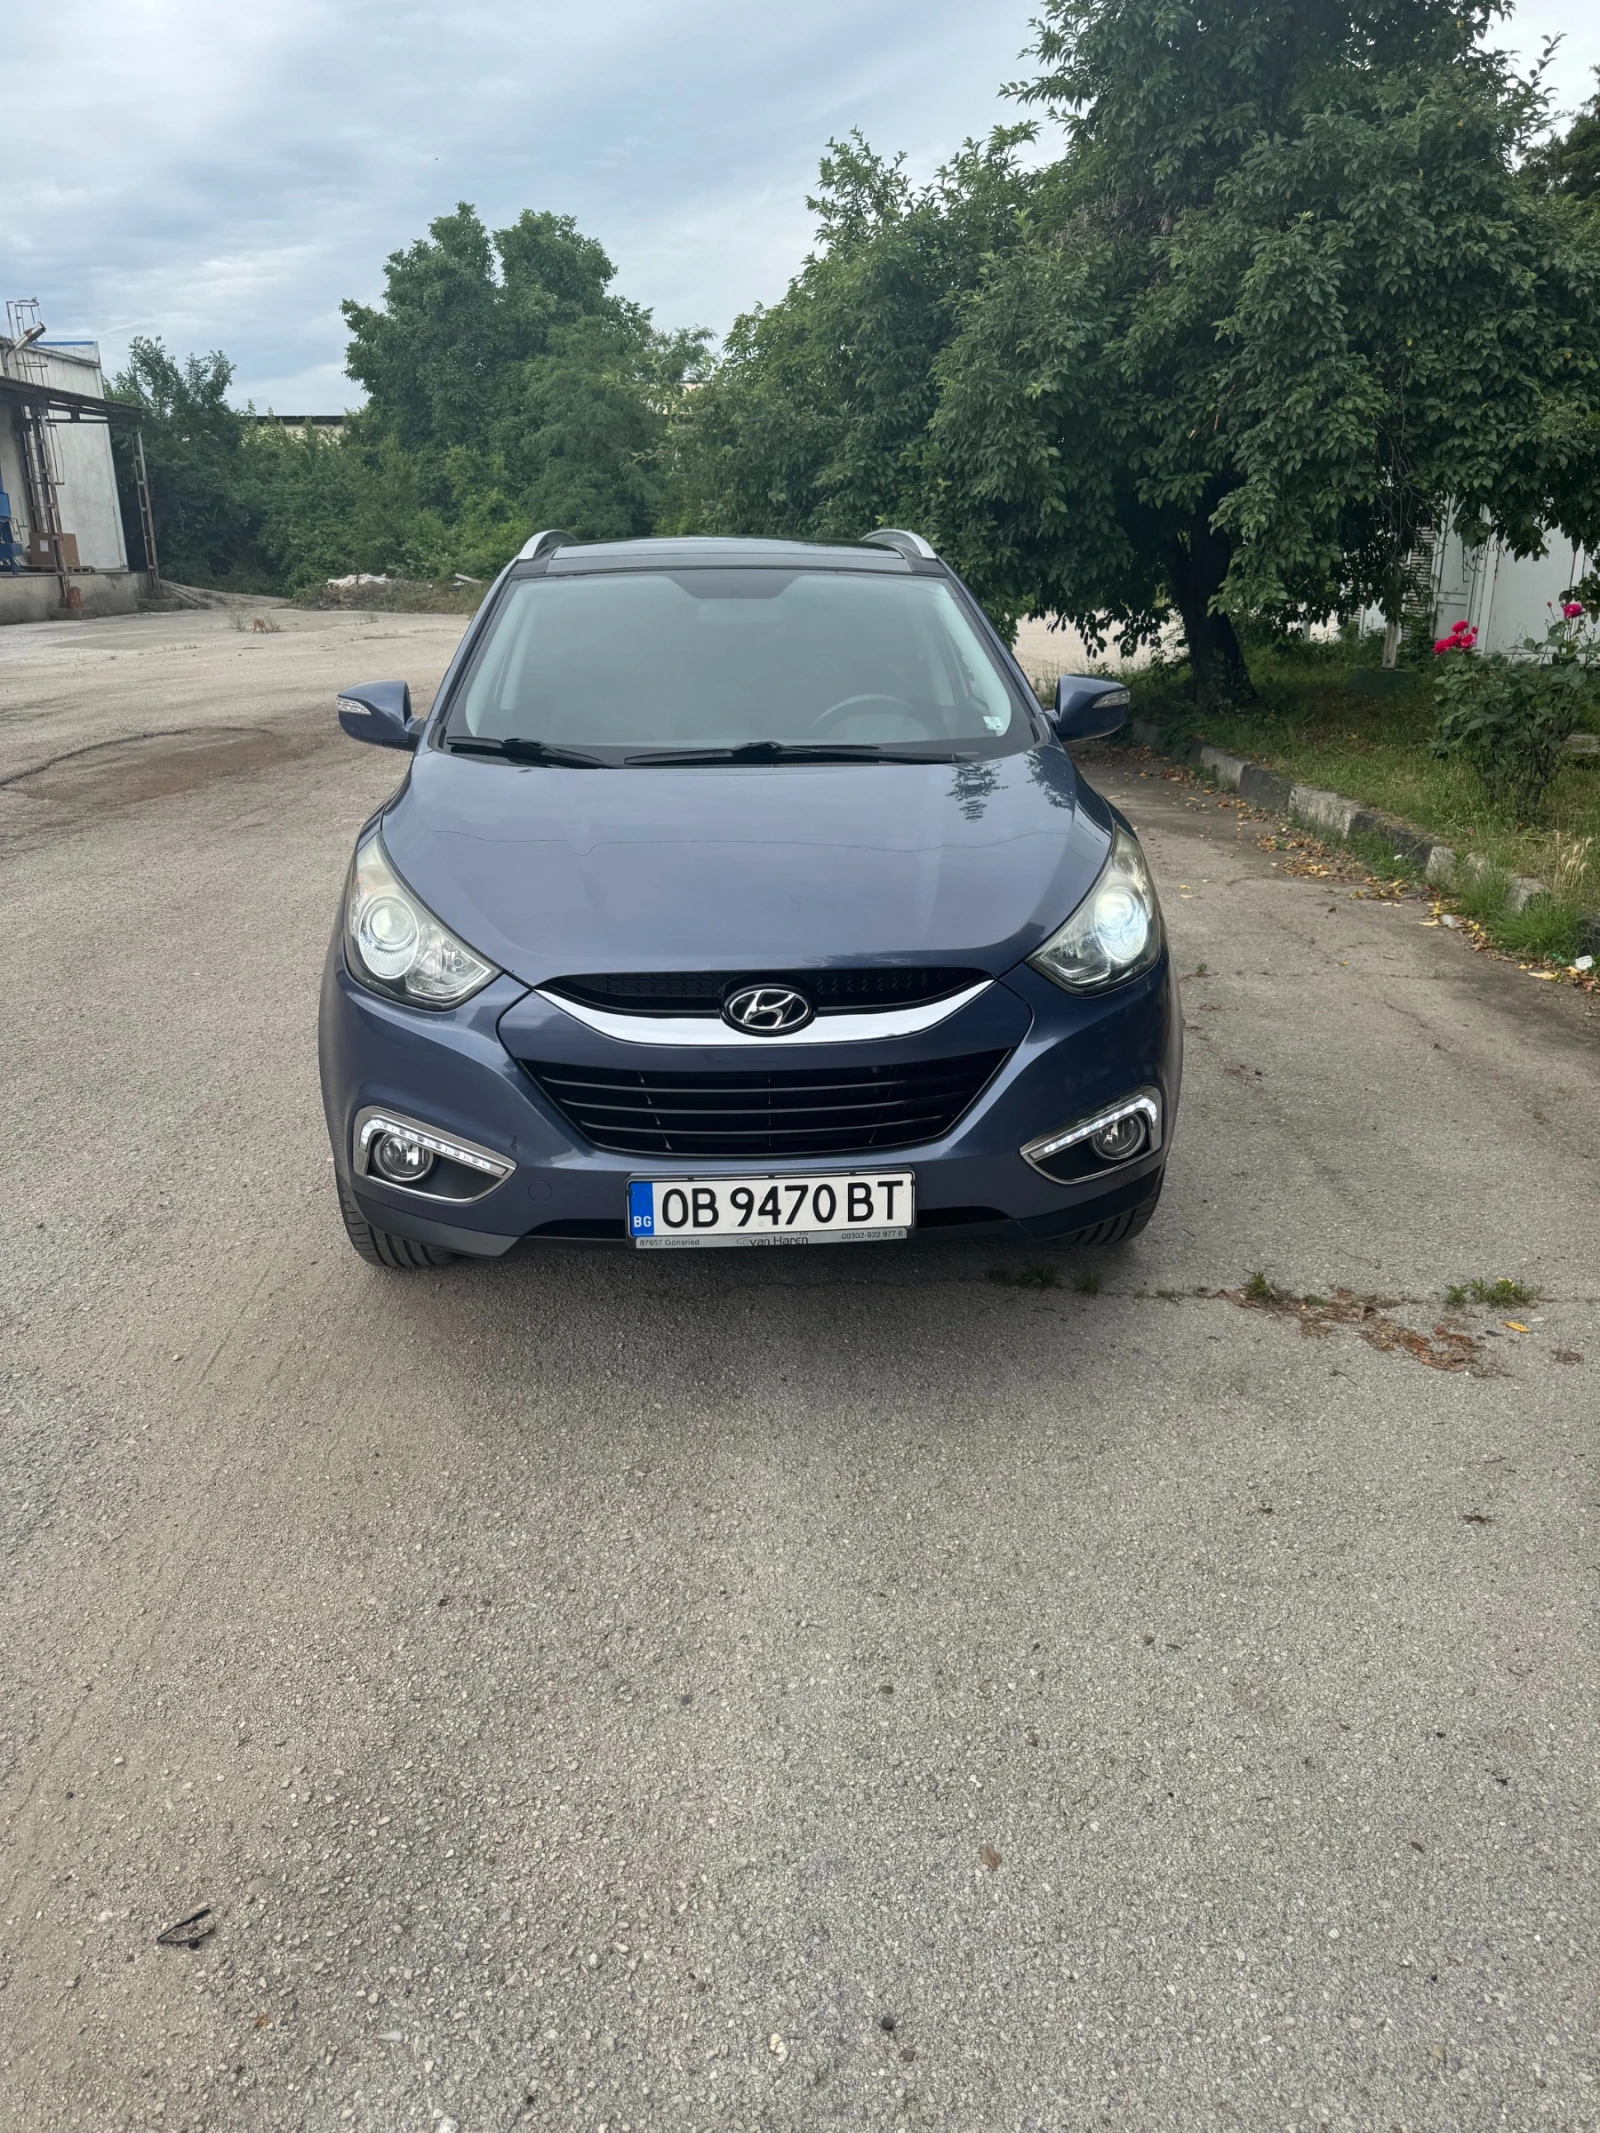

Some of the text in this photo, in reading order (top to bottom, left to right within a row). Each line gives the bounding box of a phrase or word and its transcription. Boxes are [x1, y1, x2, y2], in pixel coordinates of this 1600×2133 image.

[662, 1180, 904, 1228] OB 9470 BT
[633, 1215, 652, 1228] BG
